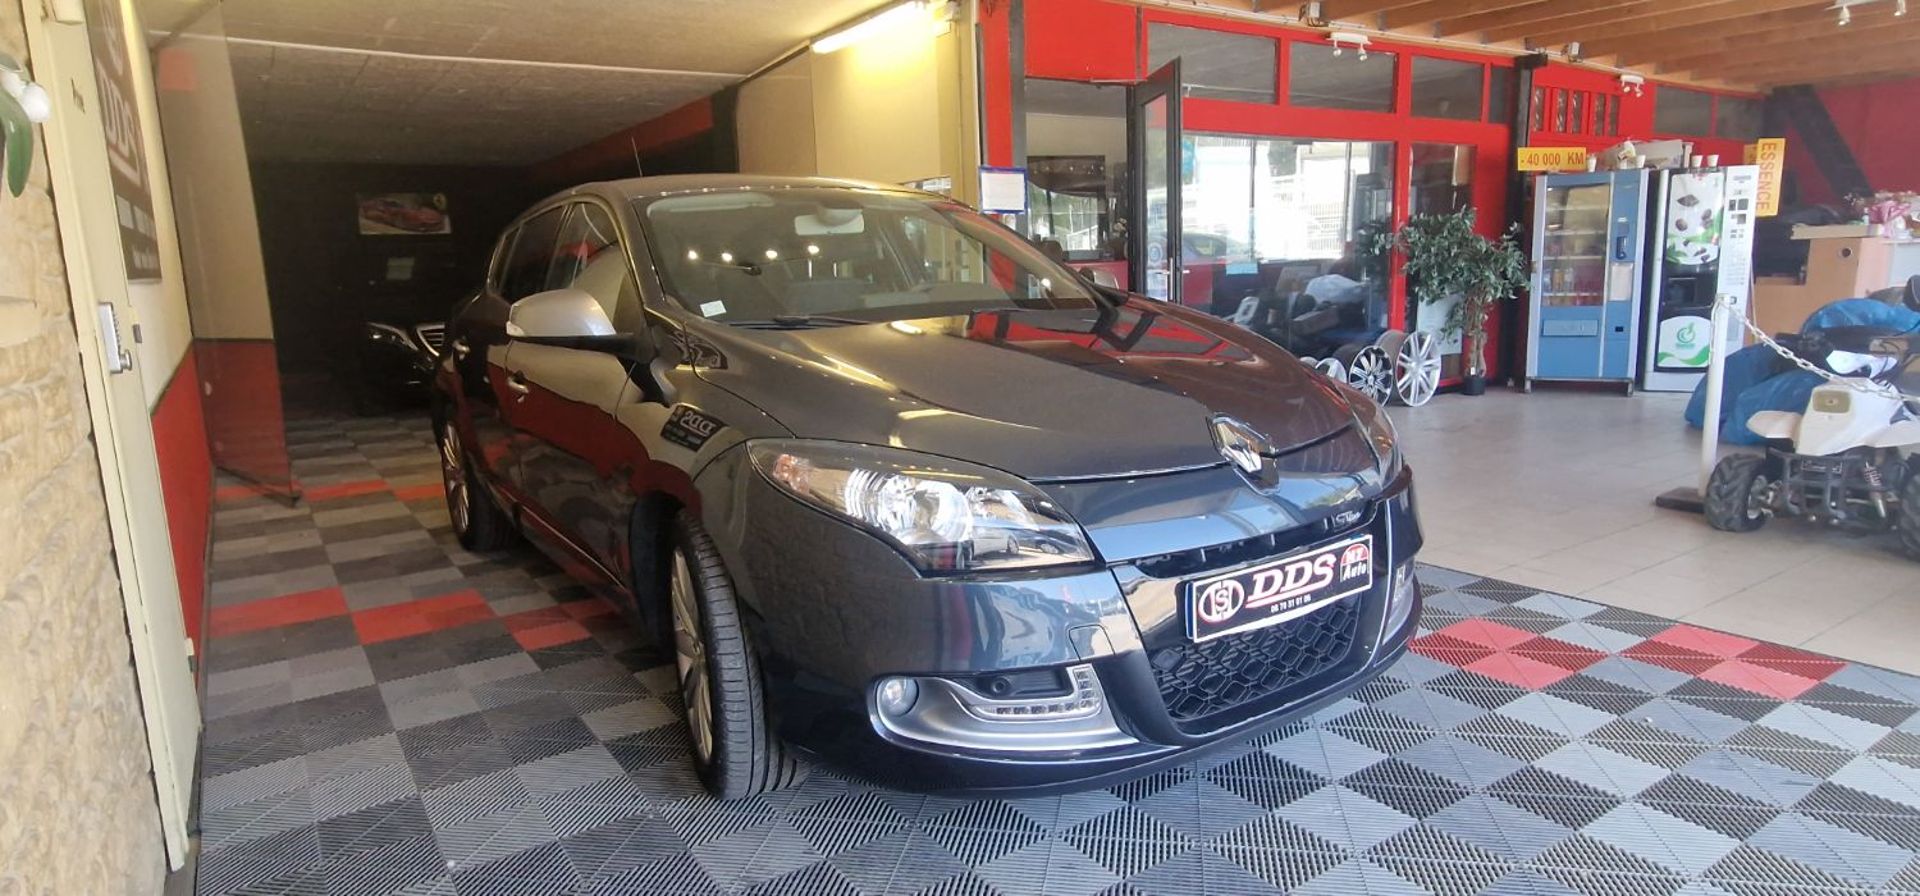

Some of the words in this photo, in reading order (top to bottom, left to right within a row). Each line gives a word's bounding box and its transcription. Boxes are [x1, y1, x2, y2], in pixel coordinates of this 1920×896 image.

[1527, 153, 1540, 166] 40
[1542, 152, 1561, 166] 000
[1567, 151, 1585, 165] KM
[1756, 142, 1778, 210] ESSENCE
[1245, 553, 1337, 605] DDS
[1342, 561, 1367, 581] Auto
